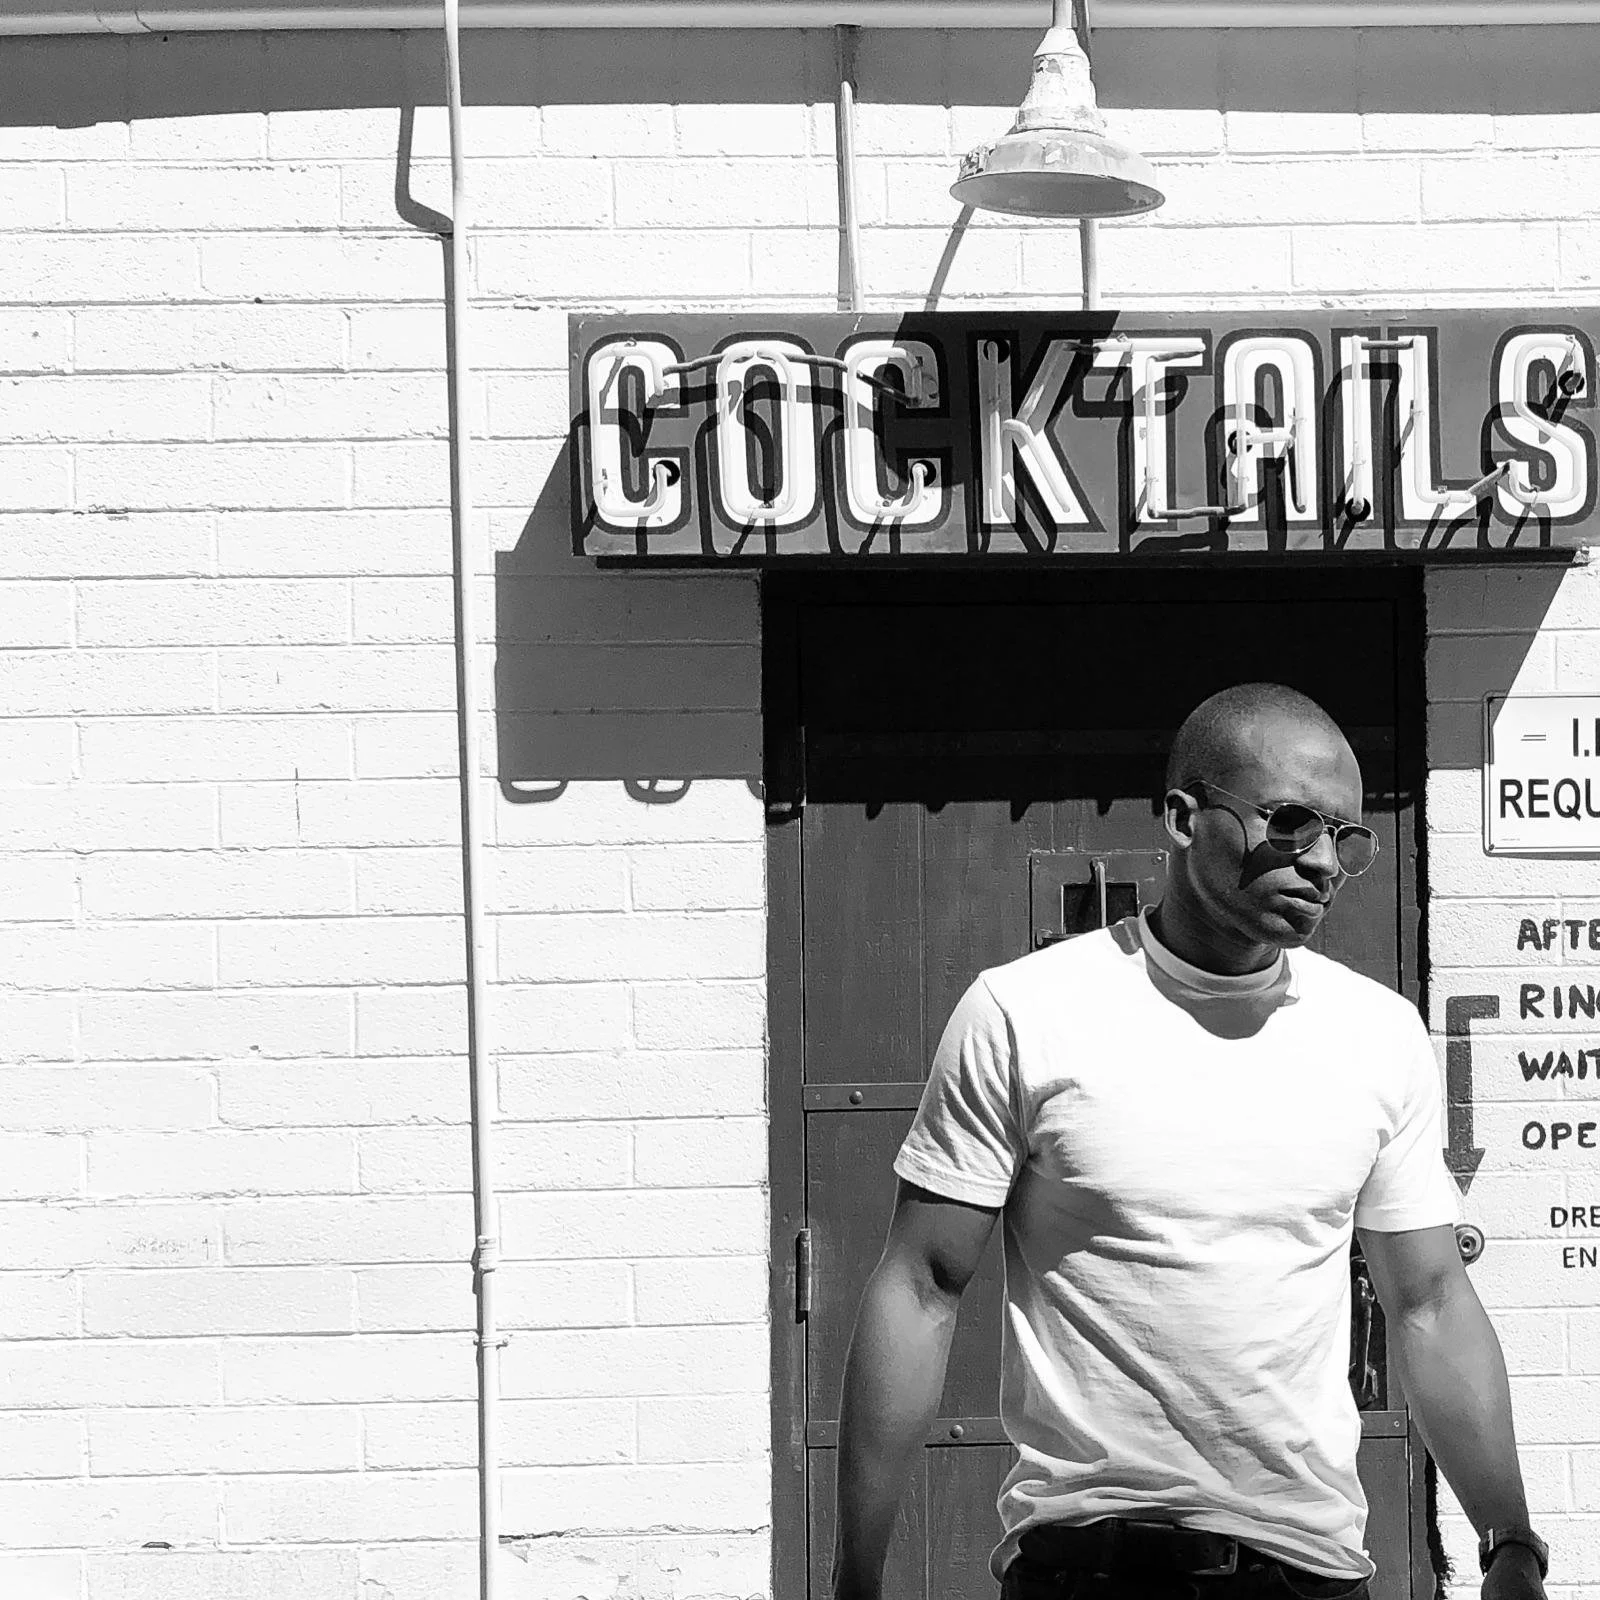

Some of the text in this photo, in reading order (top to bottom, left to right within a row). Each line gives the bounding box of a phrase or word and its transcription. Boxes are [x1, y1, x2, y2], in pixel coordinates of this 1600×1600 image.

[583, 327, 1597, 535] COCKTAILS
[1573, 718, 1600, 757] I.
[1520, 983, 1600, 1020] RIN
[1522, 1121, 1597, 1150] OPE
[1550, 1206, 1600, 1228] DRE
[1563, 1247, 1597, 1268] EN
